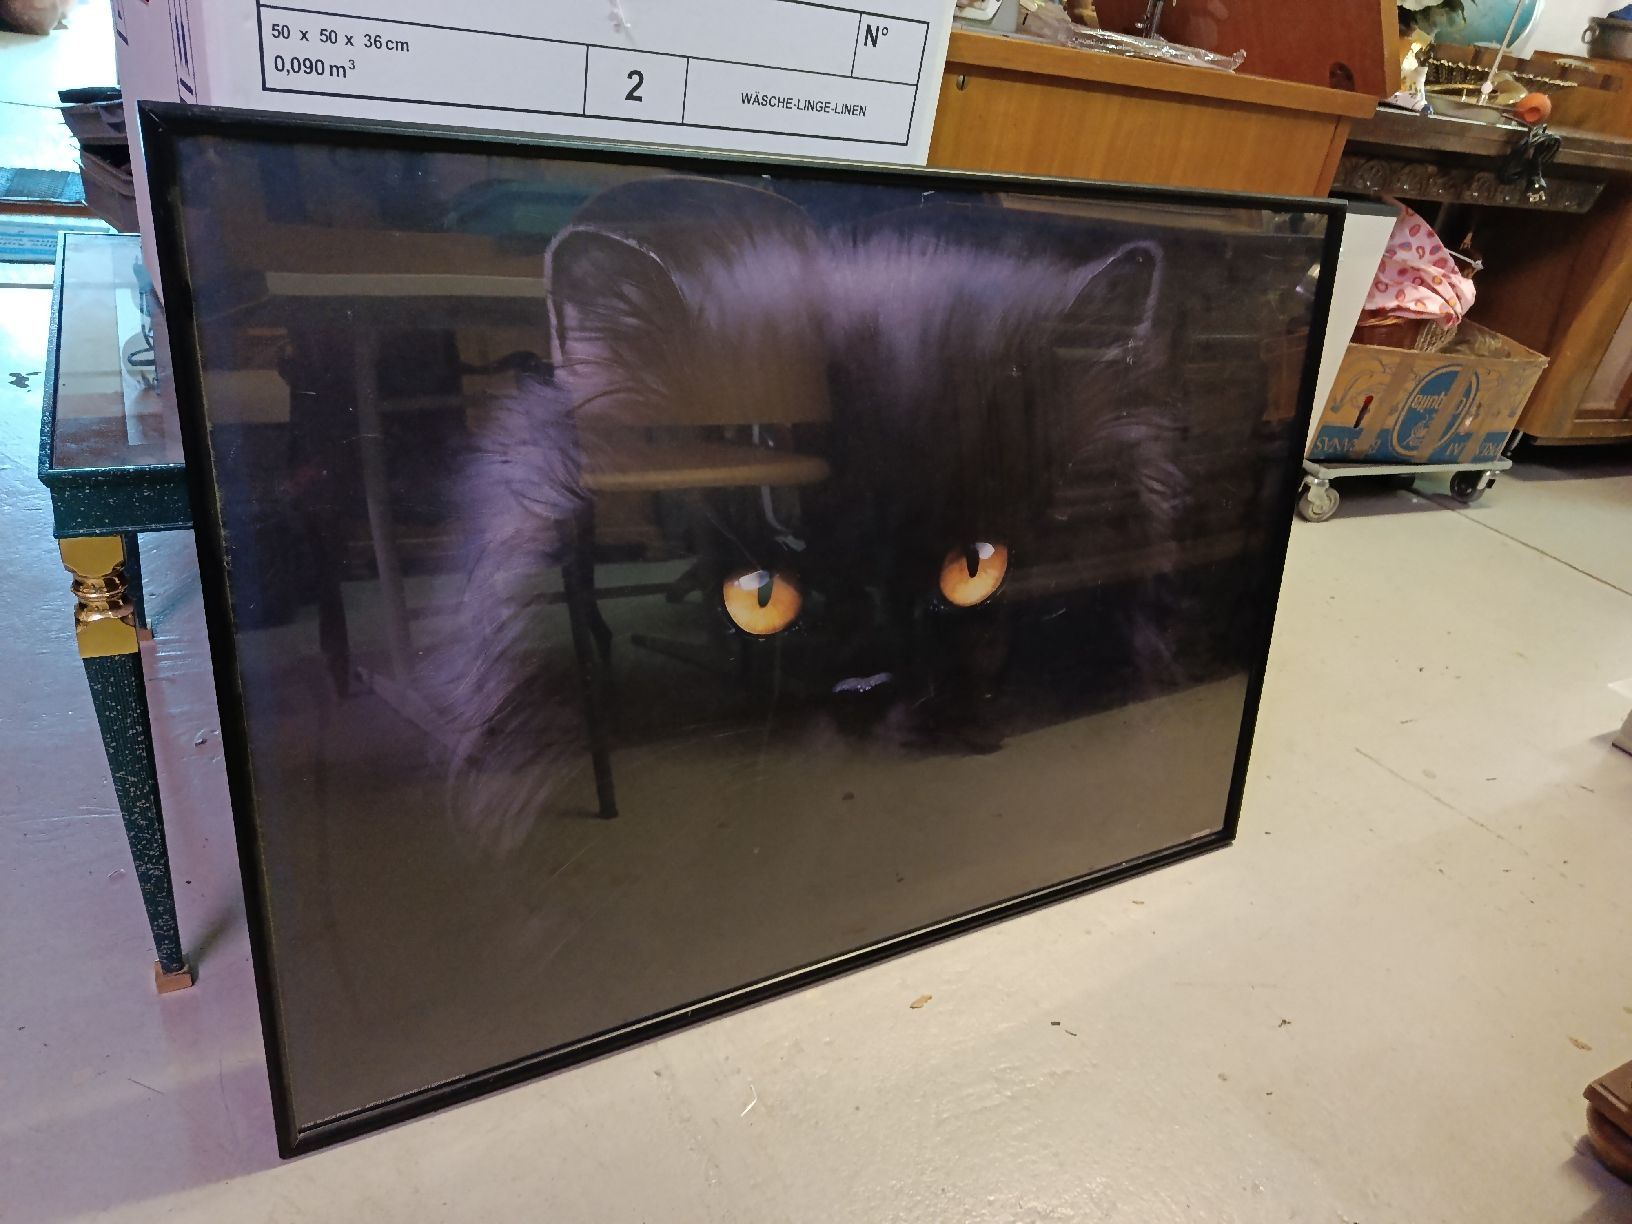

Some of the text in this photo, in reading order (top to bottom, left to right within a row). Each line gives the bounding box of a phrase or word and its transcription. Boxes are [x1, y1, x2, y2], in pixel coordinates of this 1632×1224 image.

[271, 23, 291, 40] 50
[299, 29, 310, 42] x
[319, 28, 338, 45] 50
[344, 34, 355, 47] x
[624, 69, 645, 103] 2
[740, 91, 868, 118] WÄSCHE-LINGE-LINEN
